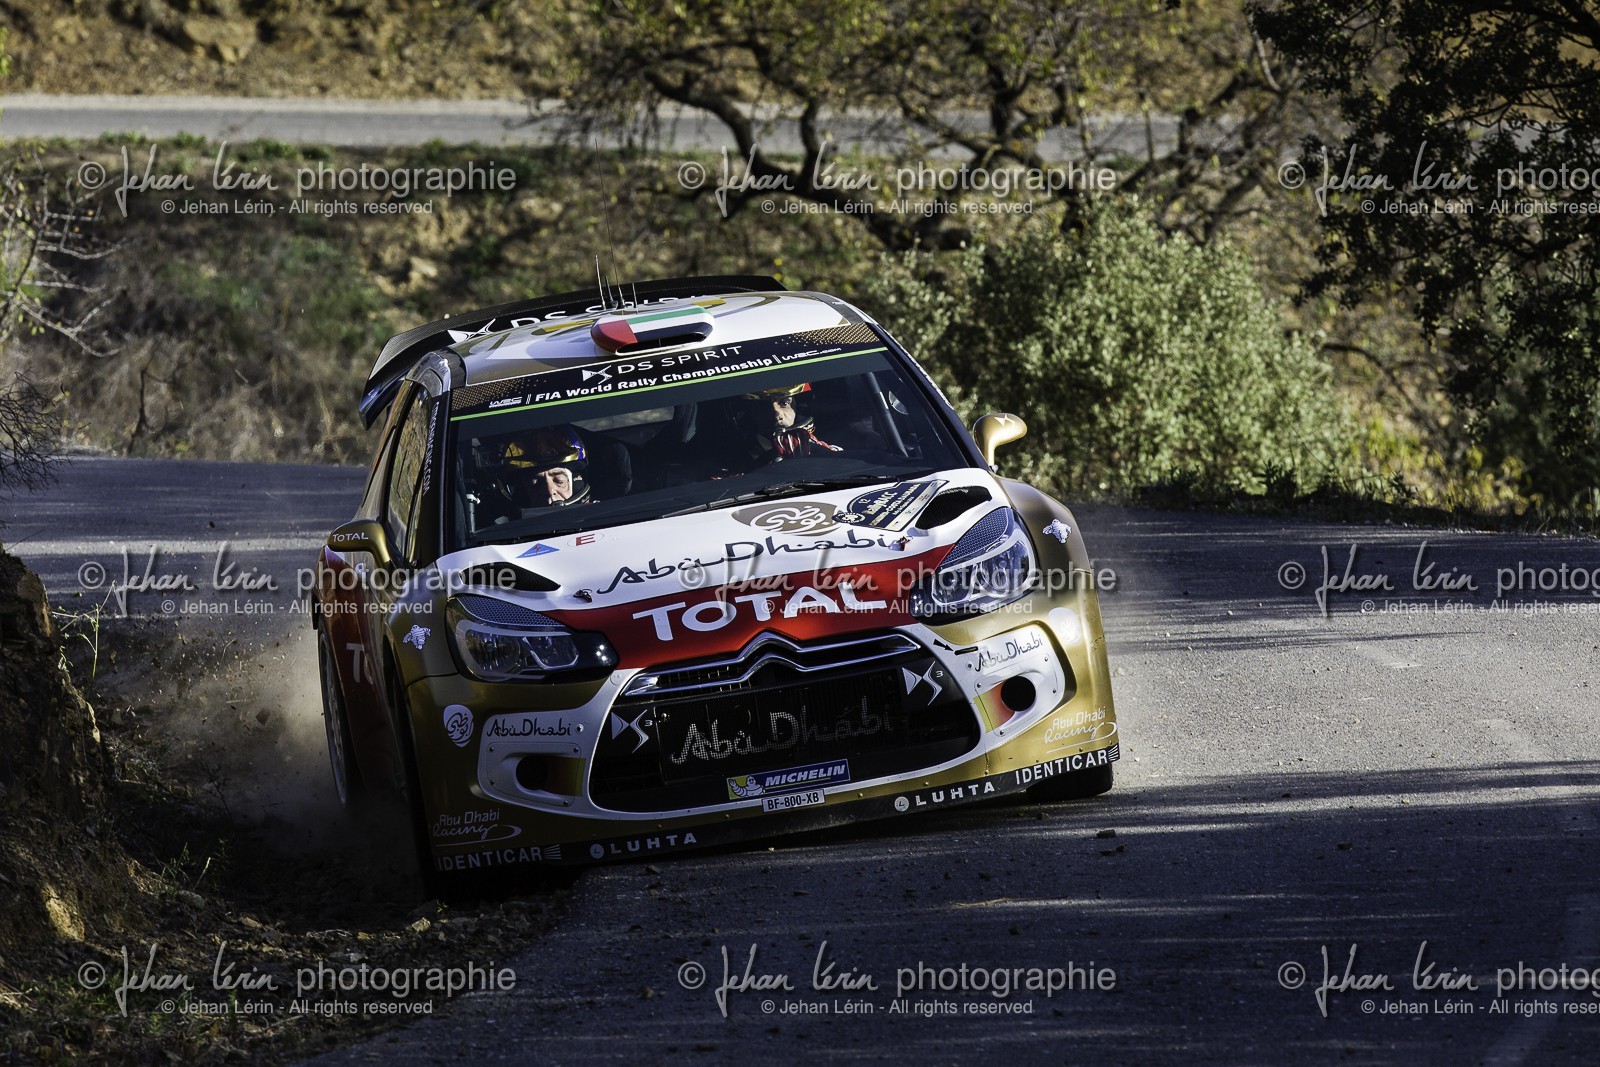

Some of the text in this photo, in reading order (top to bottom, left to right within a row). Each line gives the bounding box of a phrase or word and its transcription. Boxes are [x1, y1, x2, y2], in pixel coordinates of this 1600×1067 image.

[618, 345, 742, 375] DS SPIRIT
[535, 391, 562, 402] FIA
[566, 383, 613, 398] World
[617, 376, 660, 391] Rally
[662, 357, 773, 384] Championship
[332, 532, 369, 543] TOTAL
[575, 533, 596, 547] E
[632, 581, 888, 642] TOTAL
[1052, 706, 1106, 731] Abu Dhabi
[1043, 721, 1104, 745] Racing
[765, 764, 846, 787] MICHELIN
[1015, 748, 1109, 786] IDENTICAR
[767, 791, 820, 811] BF-800-XB
[915, 781, 996, 807] LUHTA
[439, 807, 501, 826] Abu Dhabi
[432, 823, 498, 840] Racing
[609, 832, 697, 855] LUHTA
[438, 846, 543, 871] IDENTICAR
